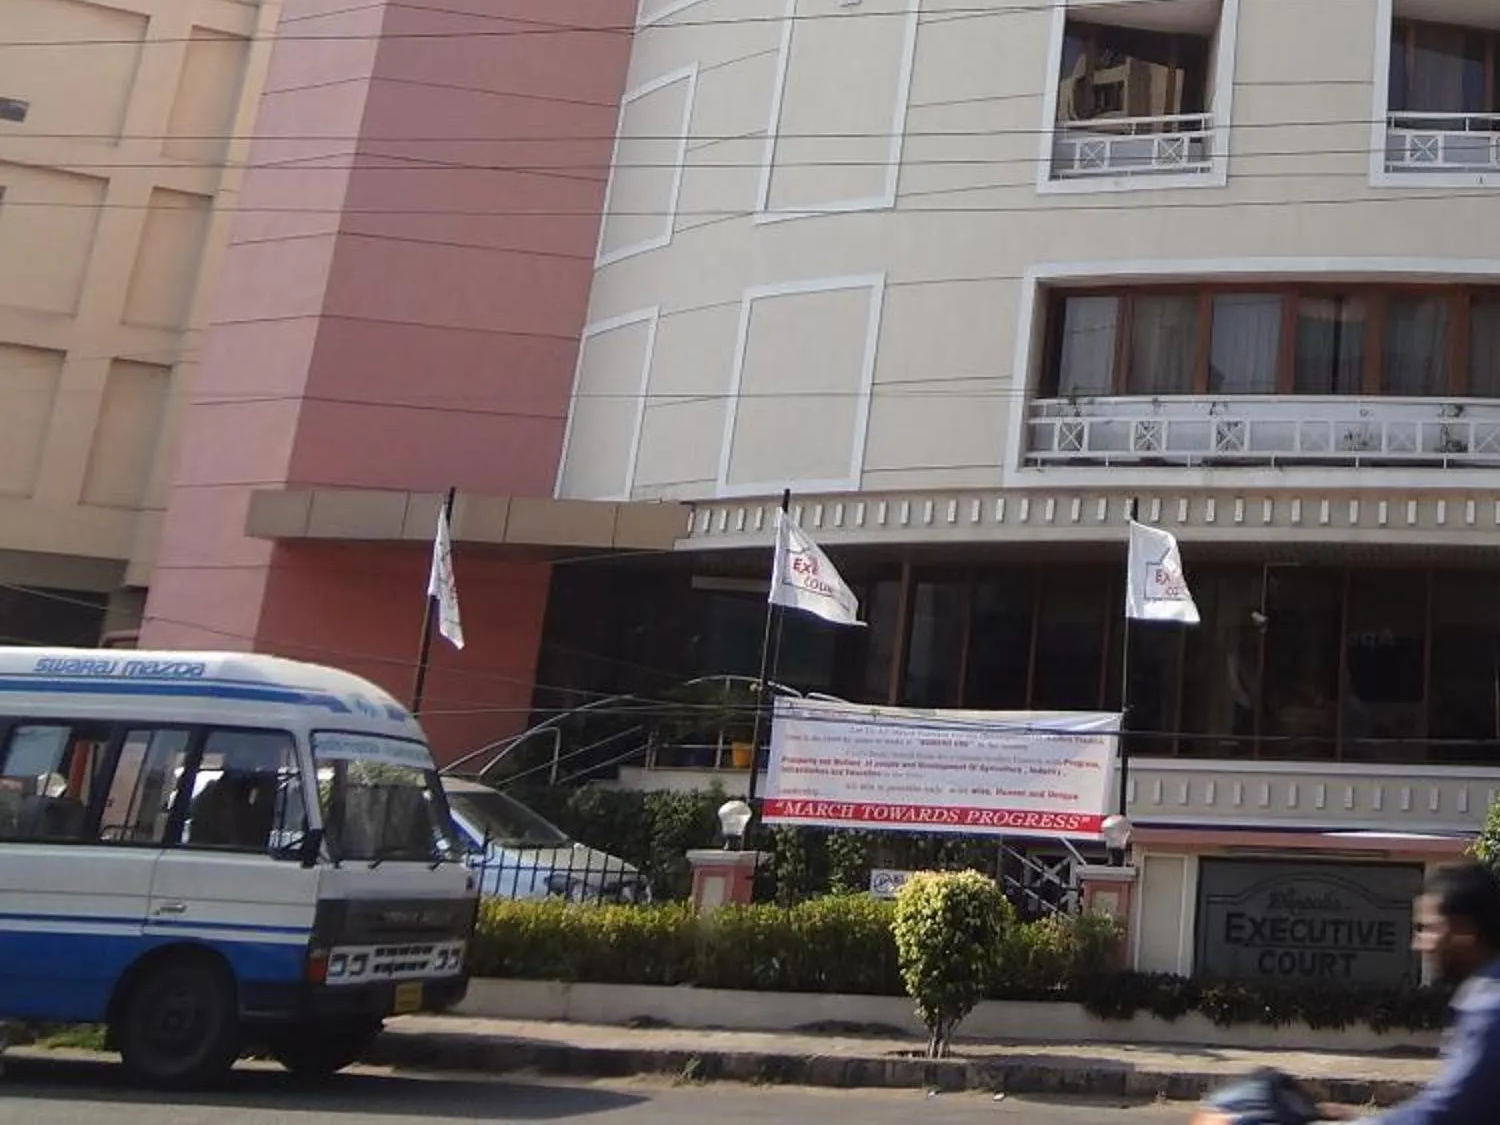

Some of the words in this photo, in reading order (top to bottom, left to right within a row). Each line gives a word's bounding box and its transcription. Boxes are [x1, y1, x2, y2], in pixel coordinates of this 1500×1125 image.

[861, 804, 959, 823] TOWARDS
[1225, 912, 1396, 946] EXECUTIVE
[1258, 950, 1357, 976] COURT
